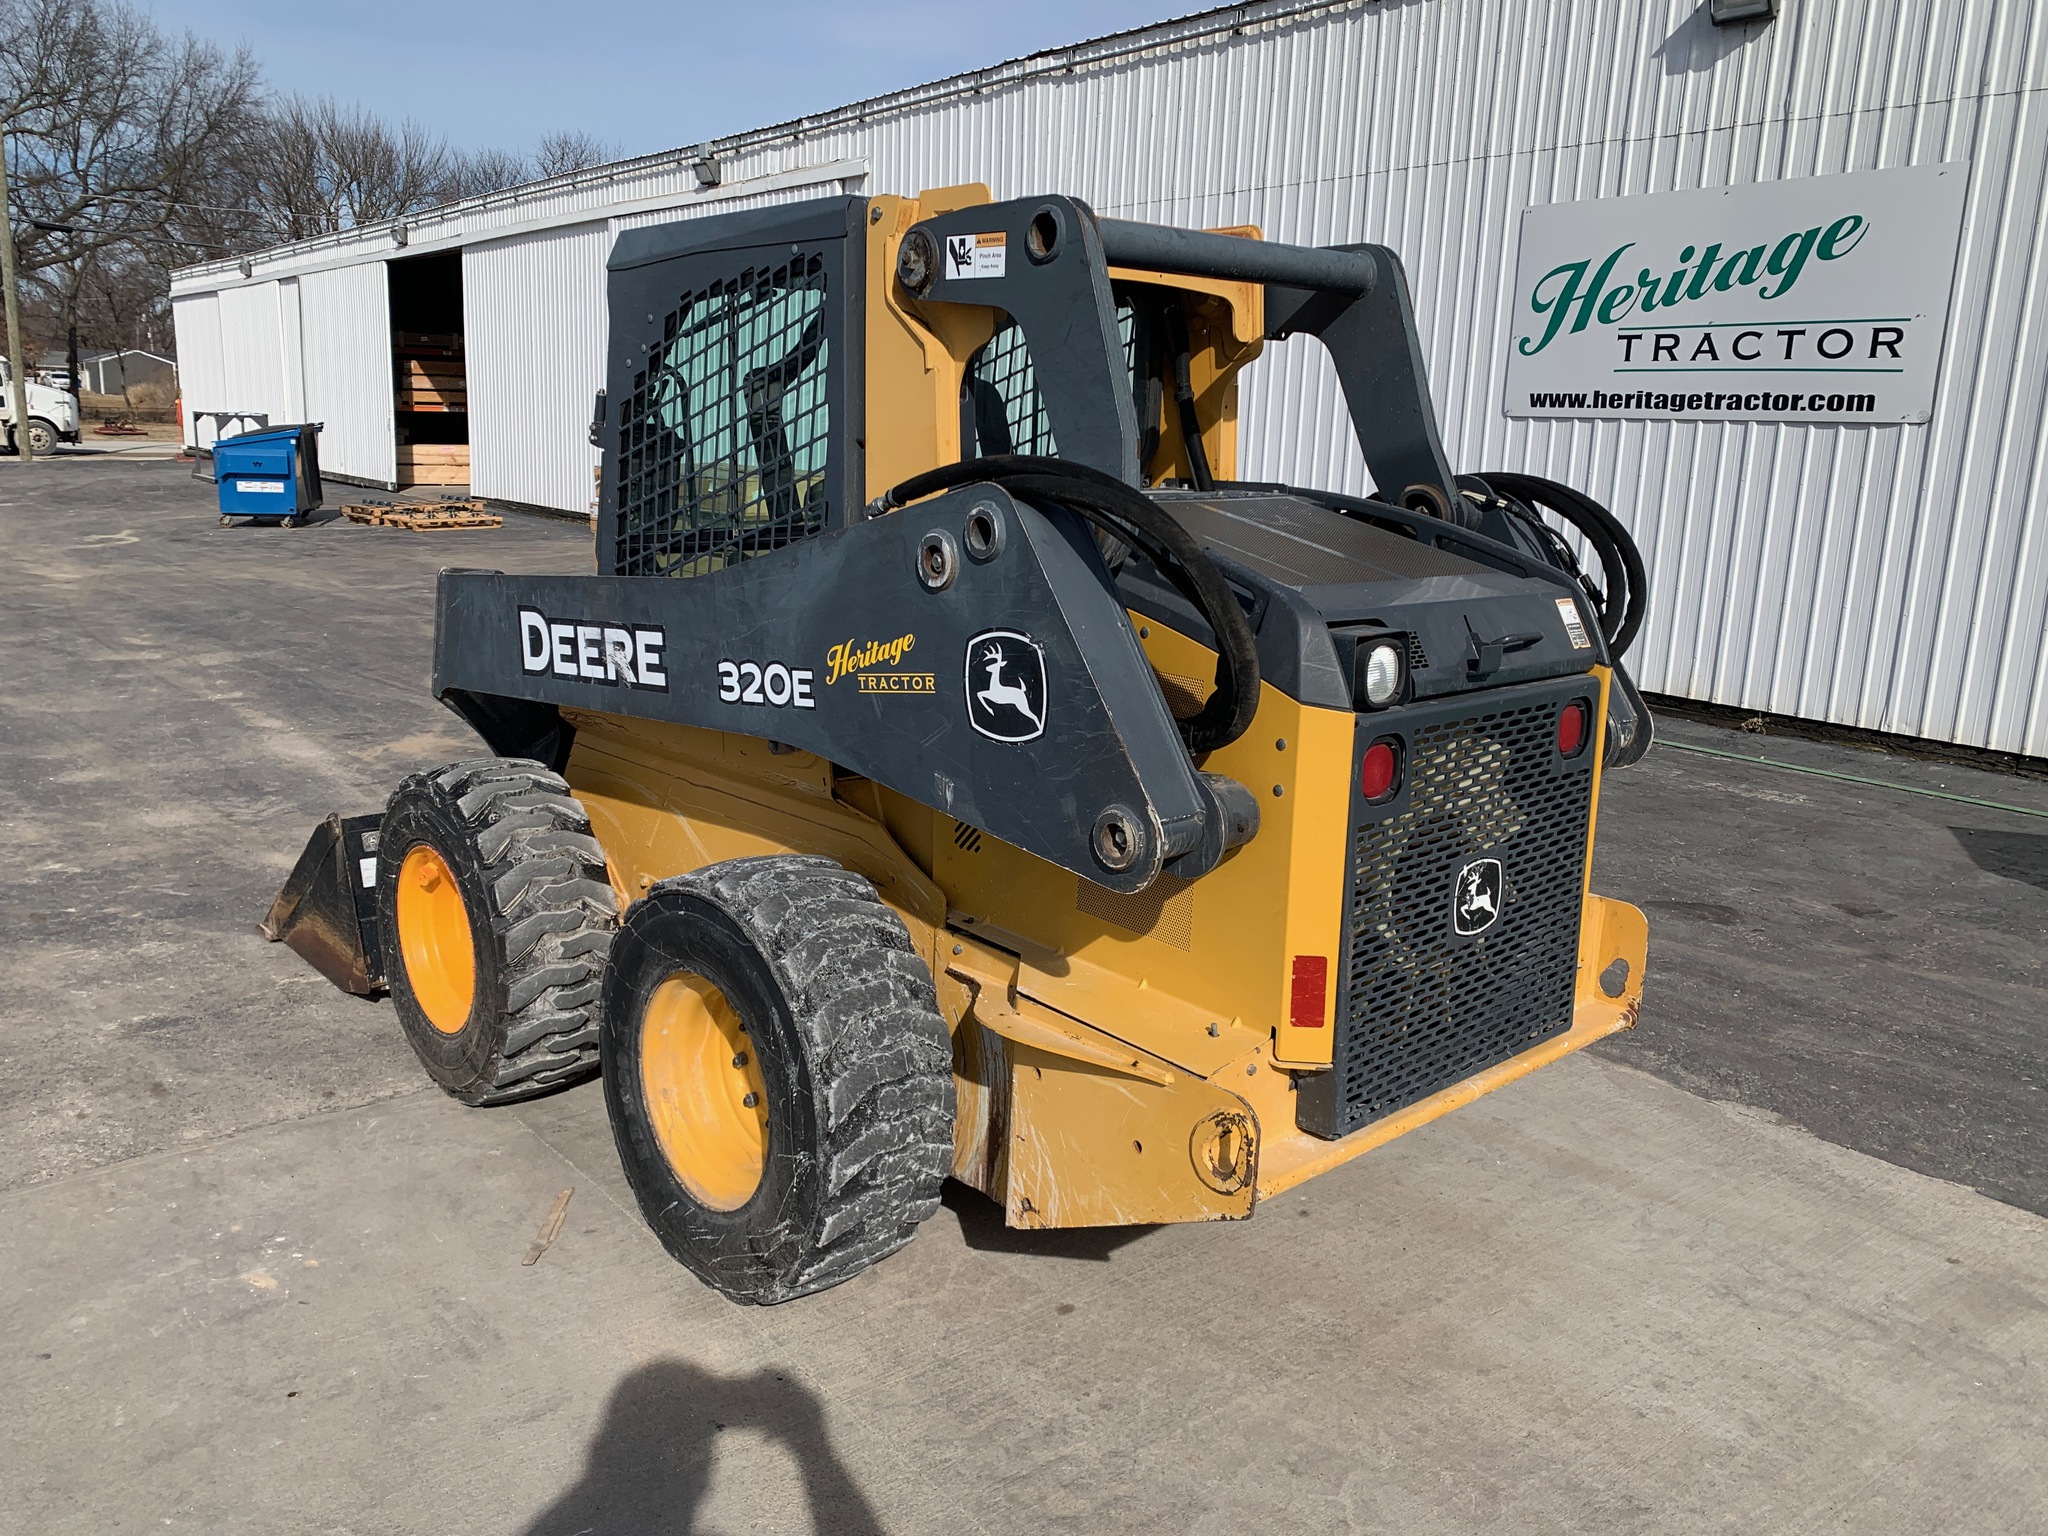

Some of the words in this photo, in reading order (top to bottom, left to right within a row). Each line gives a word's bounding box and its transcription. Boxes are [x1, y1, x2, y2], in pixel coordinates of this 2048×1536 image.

[981, 236, 1004, 244] WARNING
[1518, 214, 1871, 356] Heritage
[1617, 326, 1905, 363] TRACTOR
[1529, 390, 1876, 413] www.heritagetractor.com
[519, 610, 666, 689] DEERE
[825, 633, 916, 686] Heritage
[717, 661, 815, 708] 320E
[858, 675, 936, 691] TRACTOR
